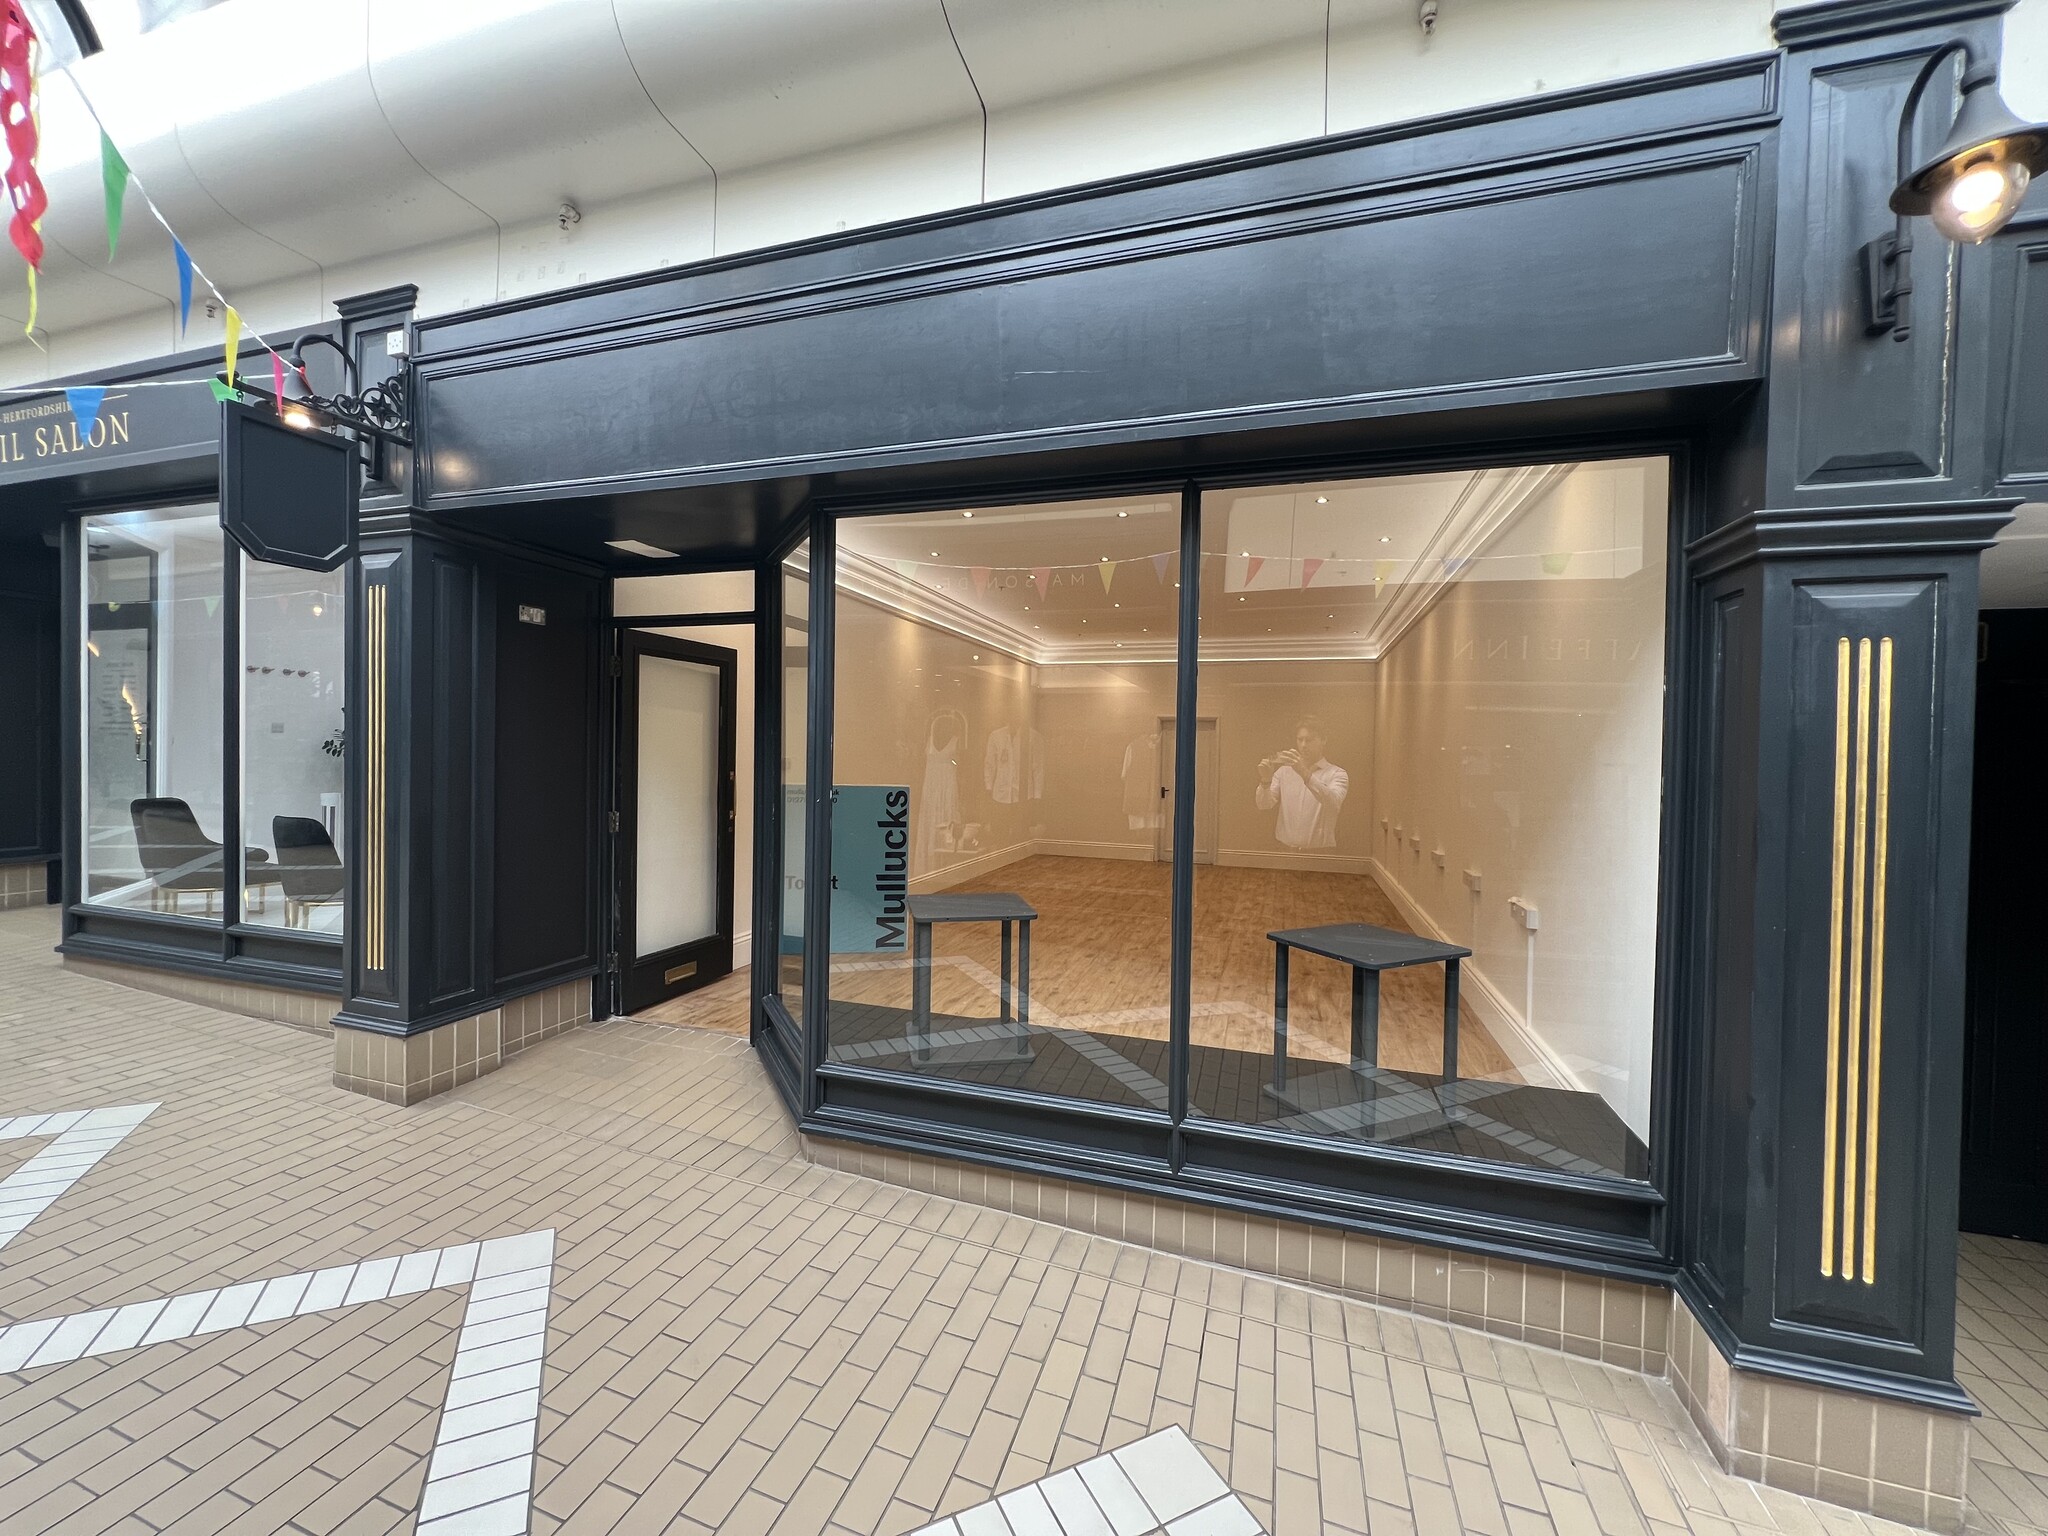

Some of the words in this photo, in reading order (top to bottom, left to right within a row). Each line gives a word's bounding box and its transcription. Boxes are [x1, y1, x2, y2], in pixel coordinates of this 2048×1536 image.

[3, 401, 73, 424] HERTFORDSHI
[35, 411, 129, 457] SALON
[875, 790, 908, 949] Mullucks
